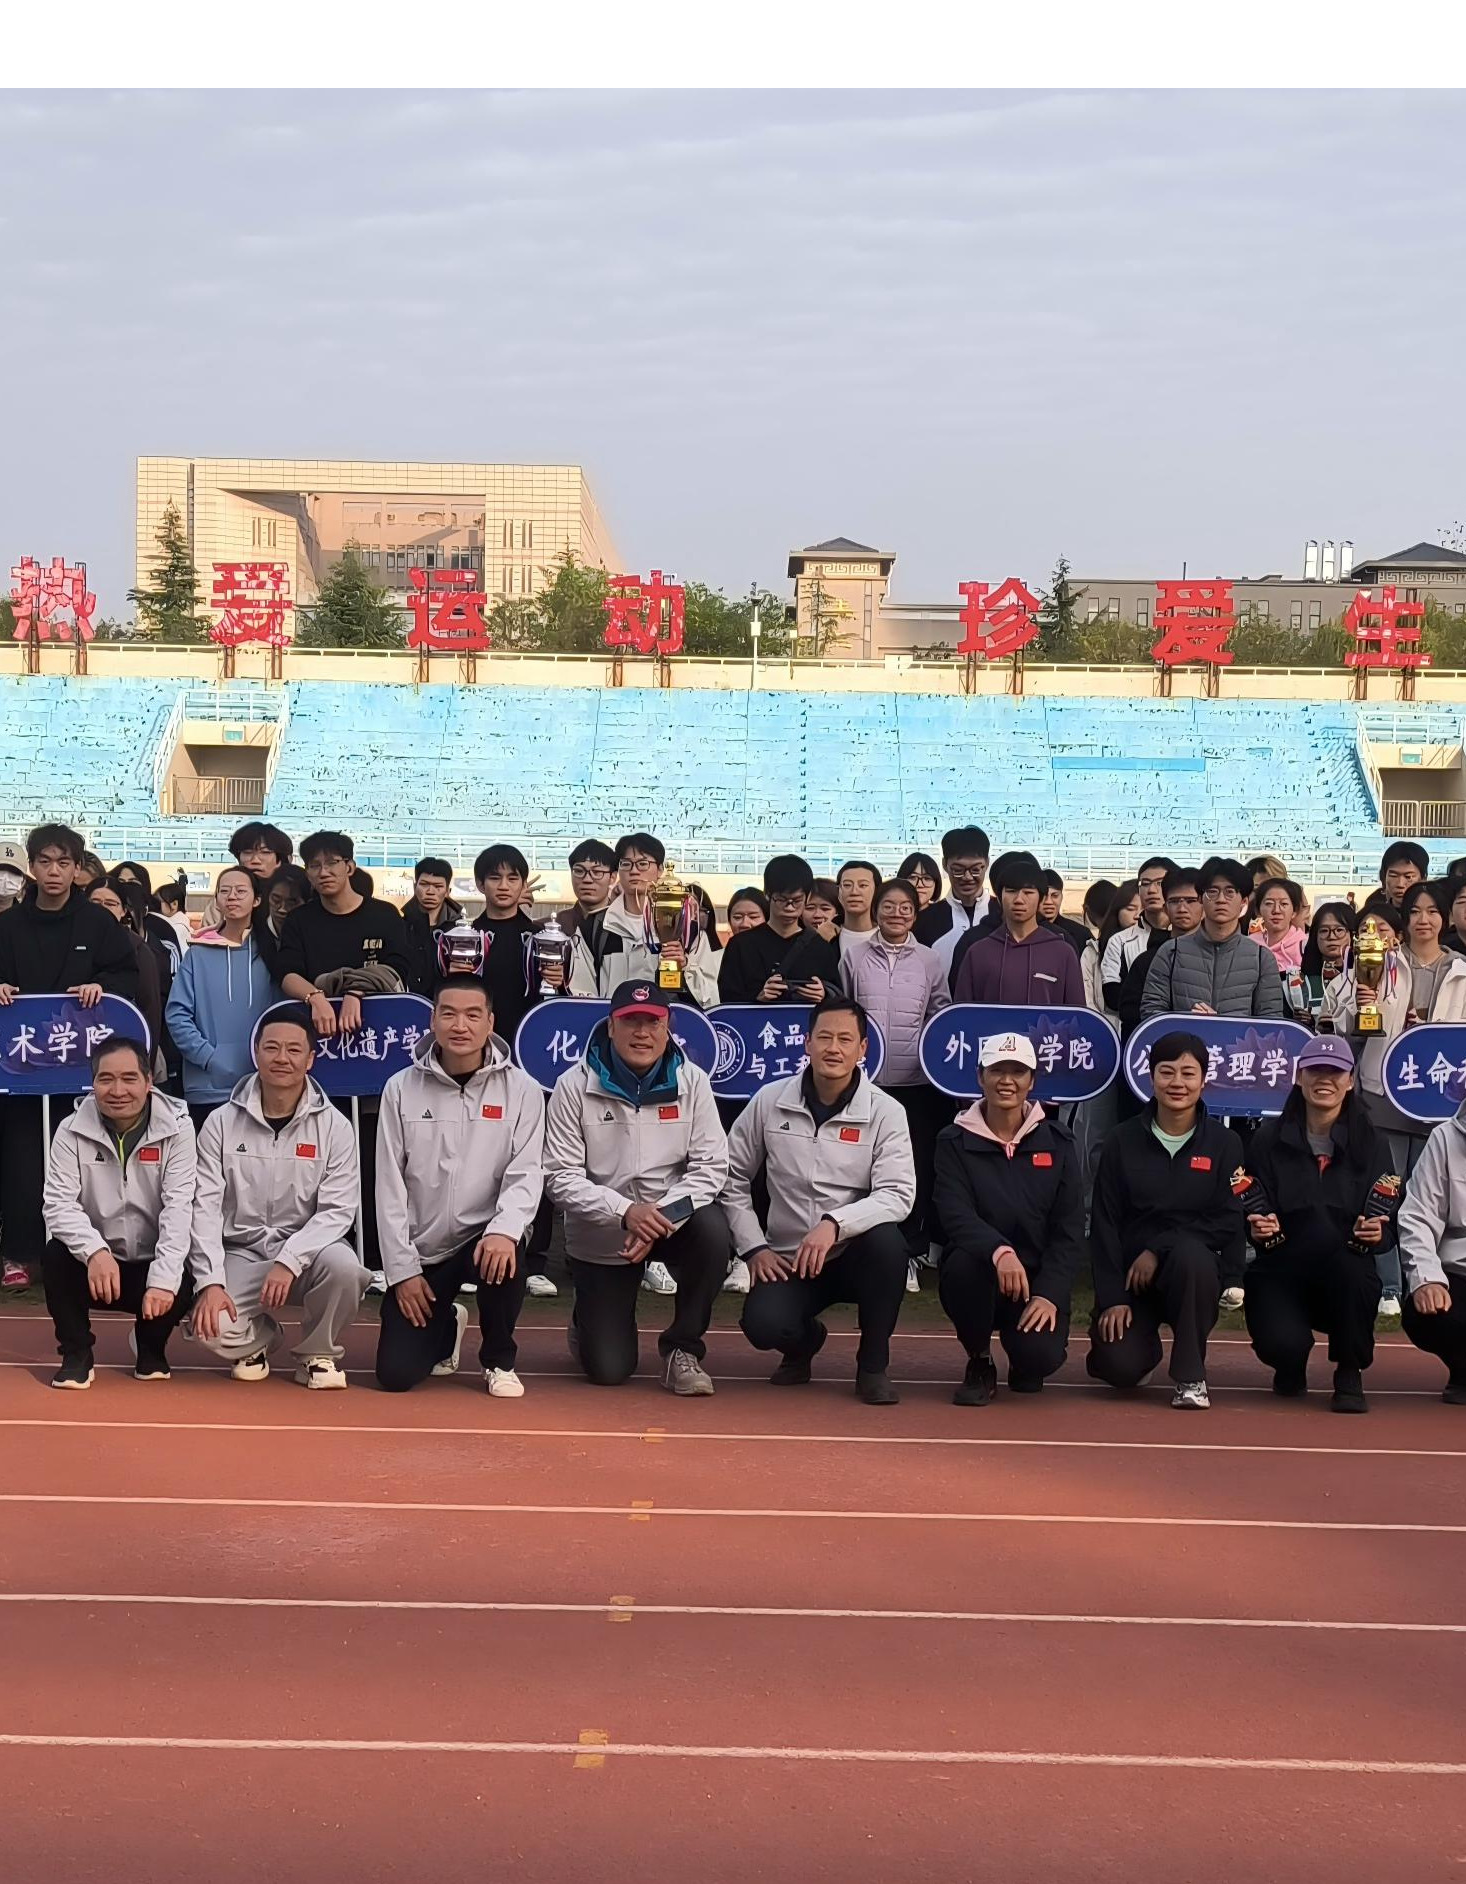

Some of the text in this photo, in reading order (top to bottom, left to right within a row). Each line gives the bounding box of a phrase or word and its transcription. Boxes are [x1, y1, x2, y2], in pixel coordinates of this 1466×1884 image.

[10, 555, 686, 656] 热爱运动
[316, 1025, 432, 1061] 文化遗产学
[758, 1021, 806, 1050] 食品
[943, 1031, 1095, 1073] 外学院
